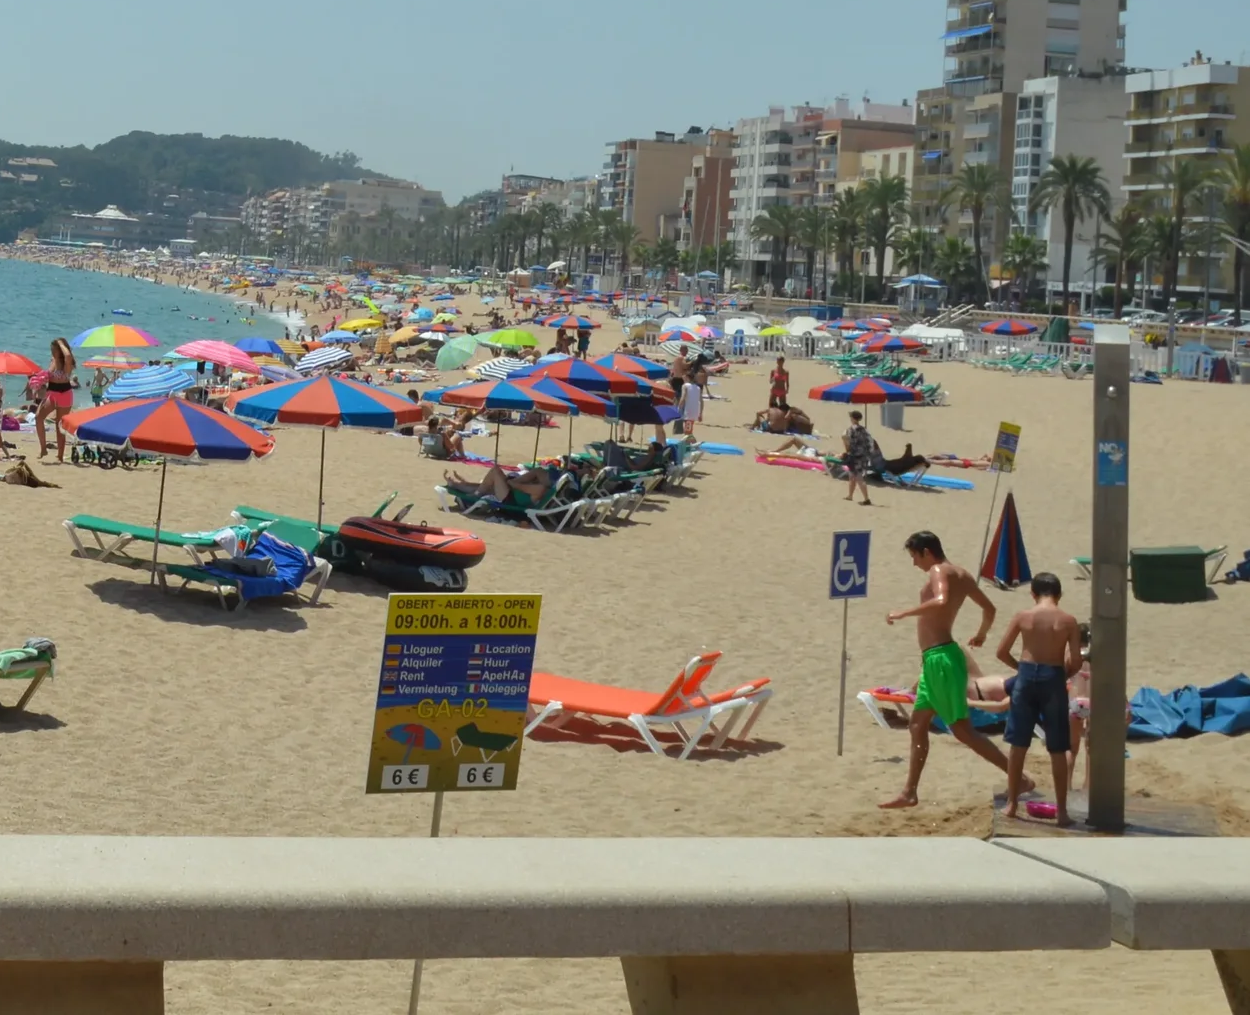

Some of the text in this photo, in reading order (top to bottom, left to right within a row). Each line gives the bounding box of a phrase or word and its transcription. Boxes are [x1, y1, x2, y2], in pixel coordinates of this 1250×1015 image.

[396, 599, 436, 610] OBERT
[444, 599, 495, 610] ABIERTO
[503, 599, 535, 610] OPEN
[394, 614, 533, 630] 09:00h. a 18:00h.
[403, 644, 444, 656] Lloguer
[485, 644, 531, 655] Location
[401, 658, 443, 669] Alquiler
[483, 658, 510, 668] Huur
[400, 672, 425, 682] Rent
[398, 685, 458, 696] Vermietung
[480, 685, 527, 696] Noleggio
[392, 769, 419, 785] 6 €
[466, 767, 494, 783] 6 €
